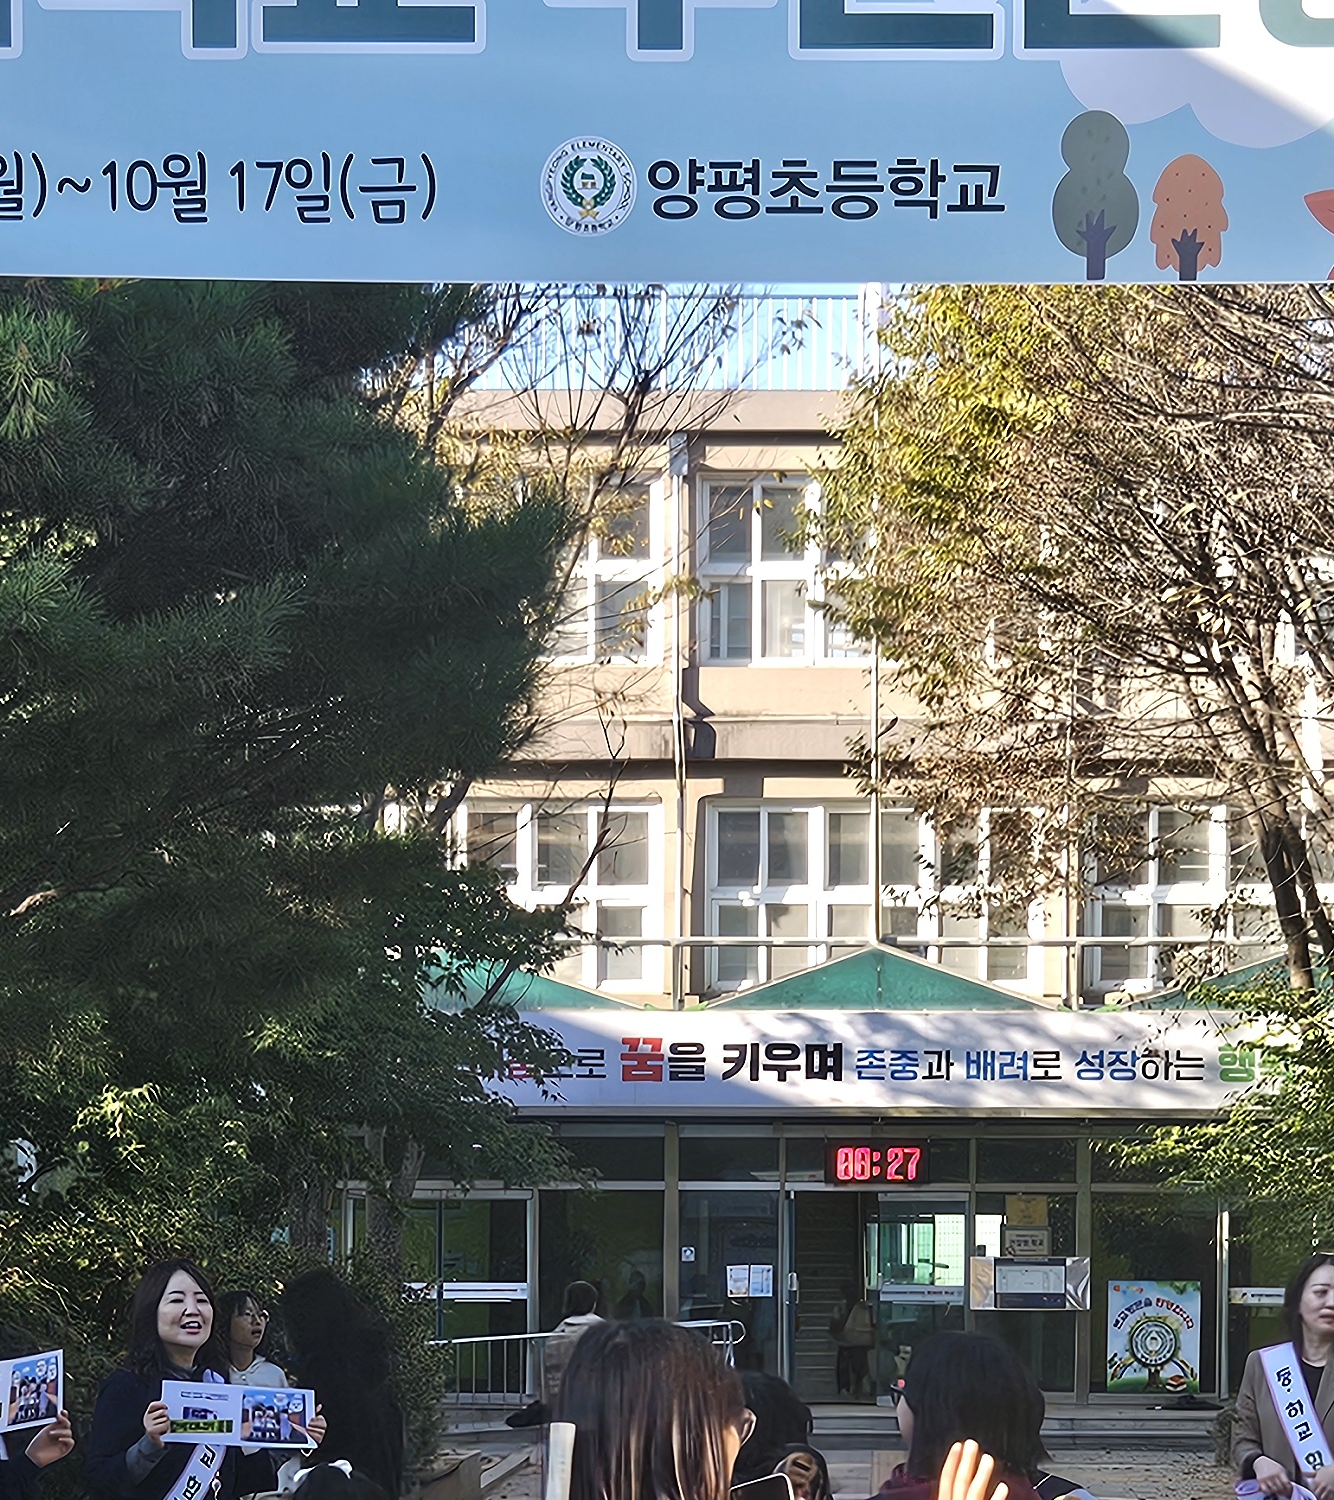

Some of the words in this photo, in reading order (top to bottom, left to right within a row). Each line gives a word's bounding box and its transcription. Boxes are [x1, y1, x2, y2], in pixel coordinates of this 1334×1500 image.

[229, 150, 437, 225] 17일(금)
[646, 157, 1007, 221] 양평초등학교
[620, 1037, 707, 1082] 꿈을
[722, 1043, 843, 1082] 키우며
[855, 1049, 956, 1082] 존중과
[966, 1049, 1063, 1082] 배려로
[1074, 1049, 1205, 1082] 성장하는
